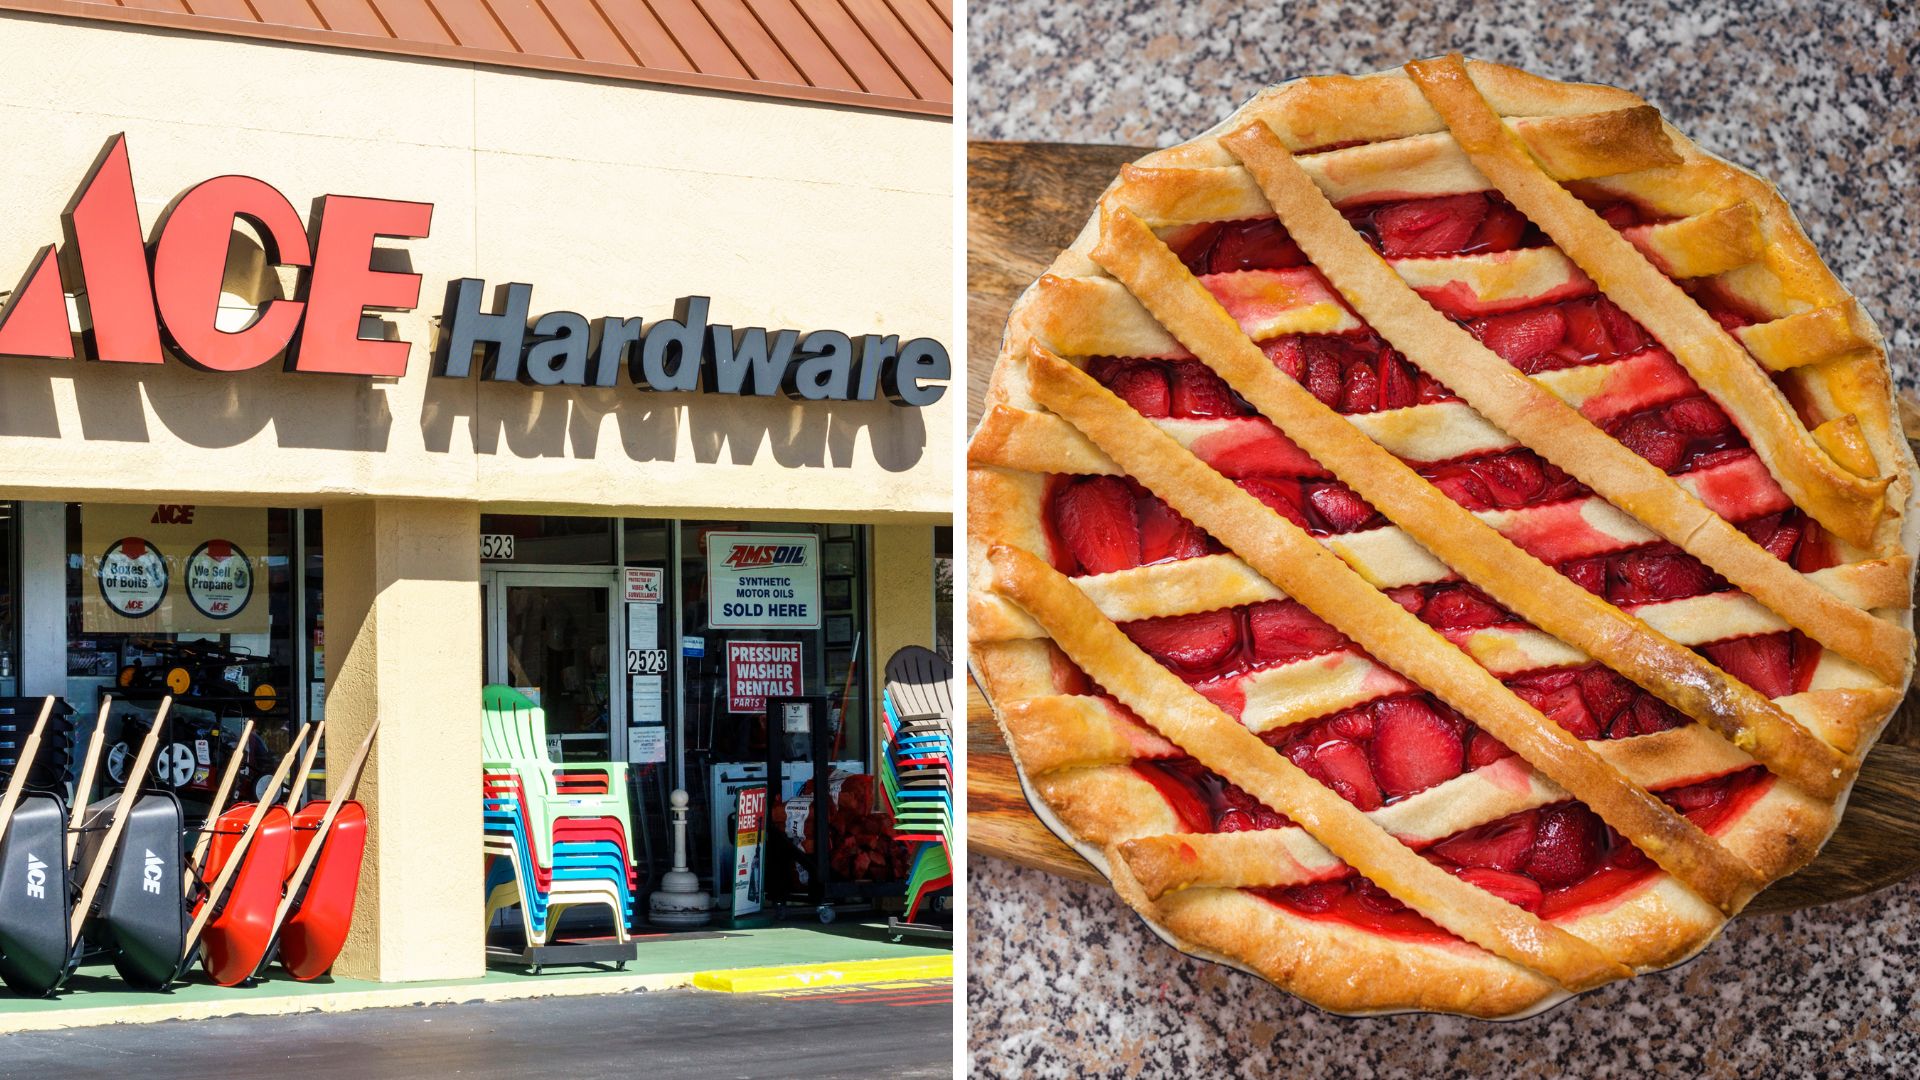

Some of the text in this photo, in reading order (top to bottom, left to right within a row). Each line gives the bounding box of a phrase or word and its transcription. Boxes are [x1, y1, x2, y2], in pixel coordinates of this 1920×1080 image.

[0, 132, 951, 407] ACE Hardware
[151, 504, 195, 524] ACE
[725, 544, 804, 568] AMSOIL
[110, 563, 143, 575] Boxes
[194, 565, 231, 578] We Sell
[106, 577, 148, 588] of Bolts
[192, 578, 233, 591] Propane
[739, 577, 791, 586] SYNTHETIC
[736, 589, 794, 598] MOTOR OILS
[124, 600, 143, 610] ACE
[210, 602, 229, 611] ACE
[723, 603, 807, 617] SOLD HERE
[628, 650, 666, 673] 2523
[731, 646, 798, 662] PRESSURE
[736, 663, 793, 679] WASHER
[736, 680, 794, 696] RENTALS
[734, 698, 760, 707] PARTS
[739, 792, 765, 815] RENT
[738, 814, 756, 829] HERE
[27, 852, 48, 899] ACE
[143, 848, 164, 895] ACE
